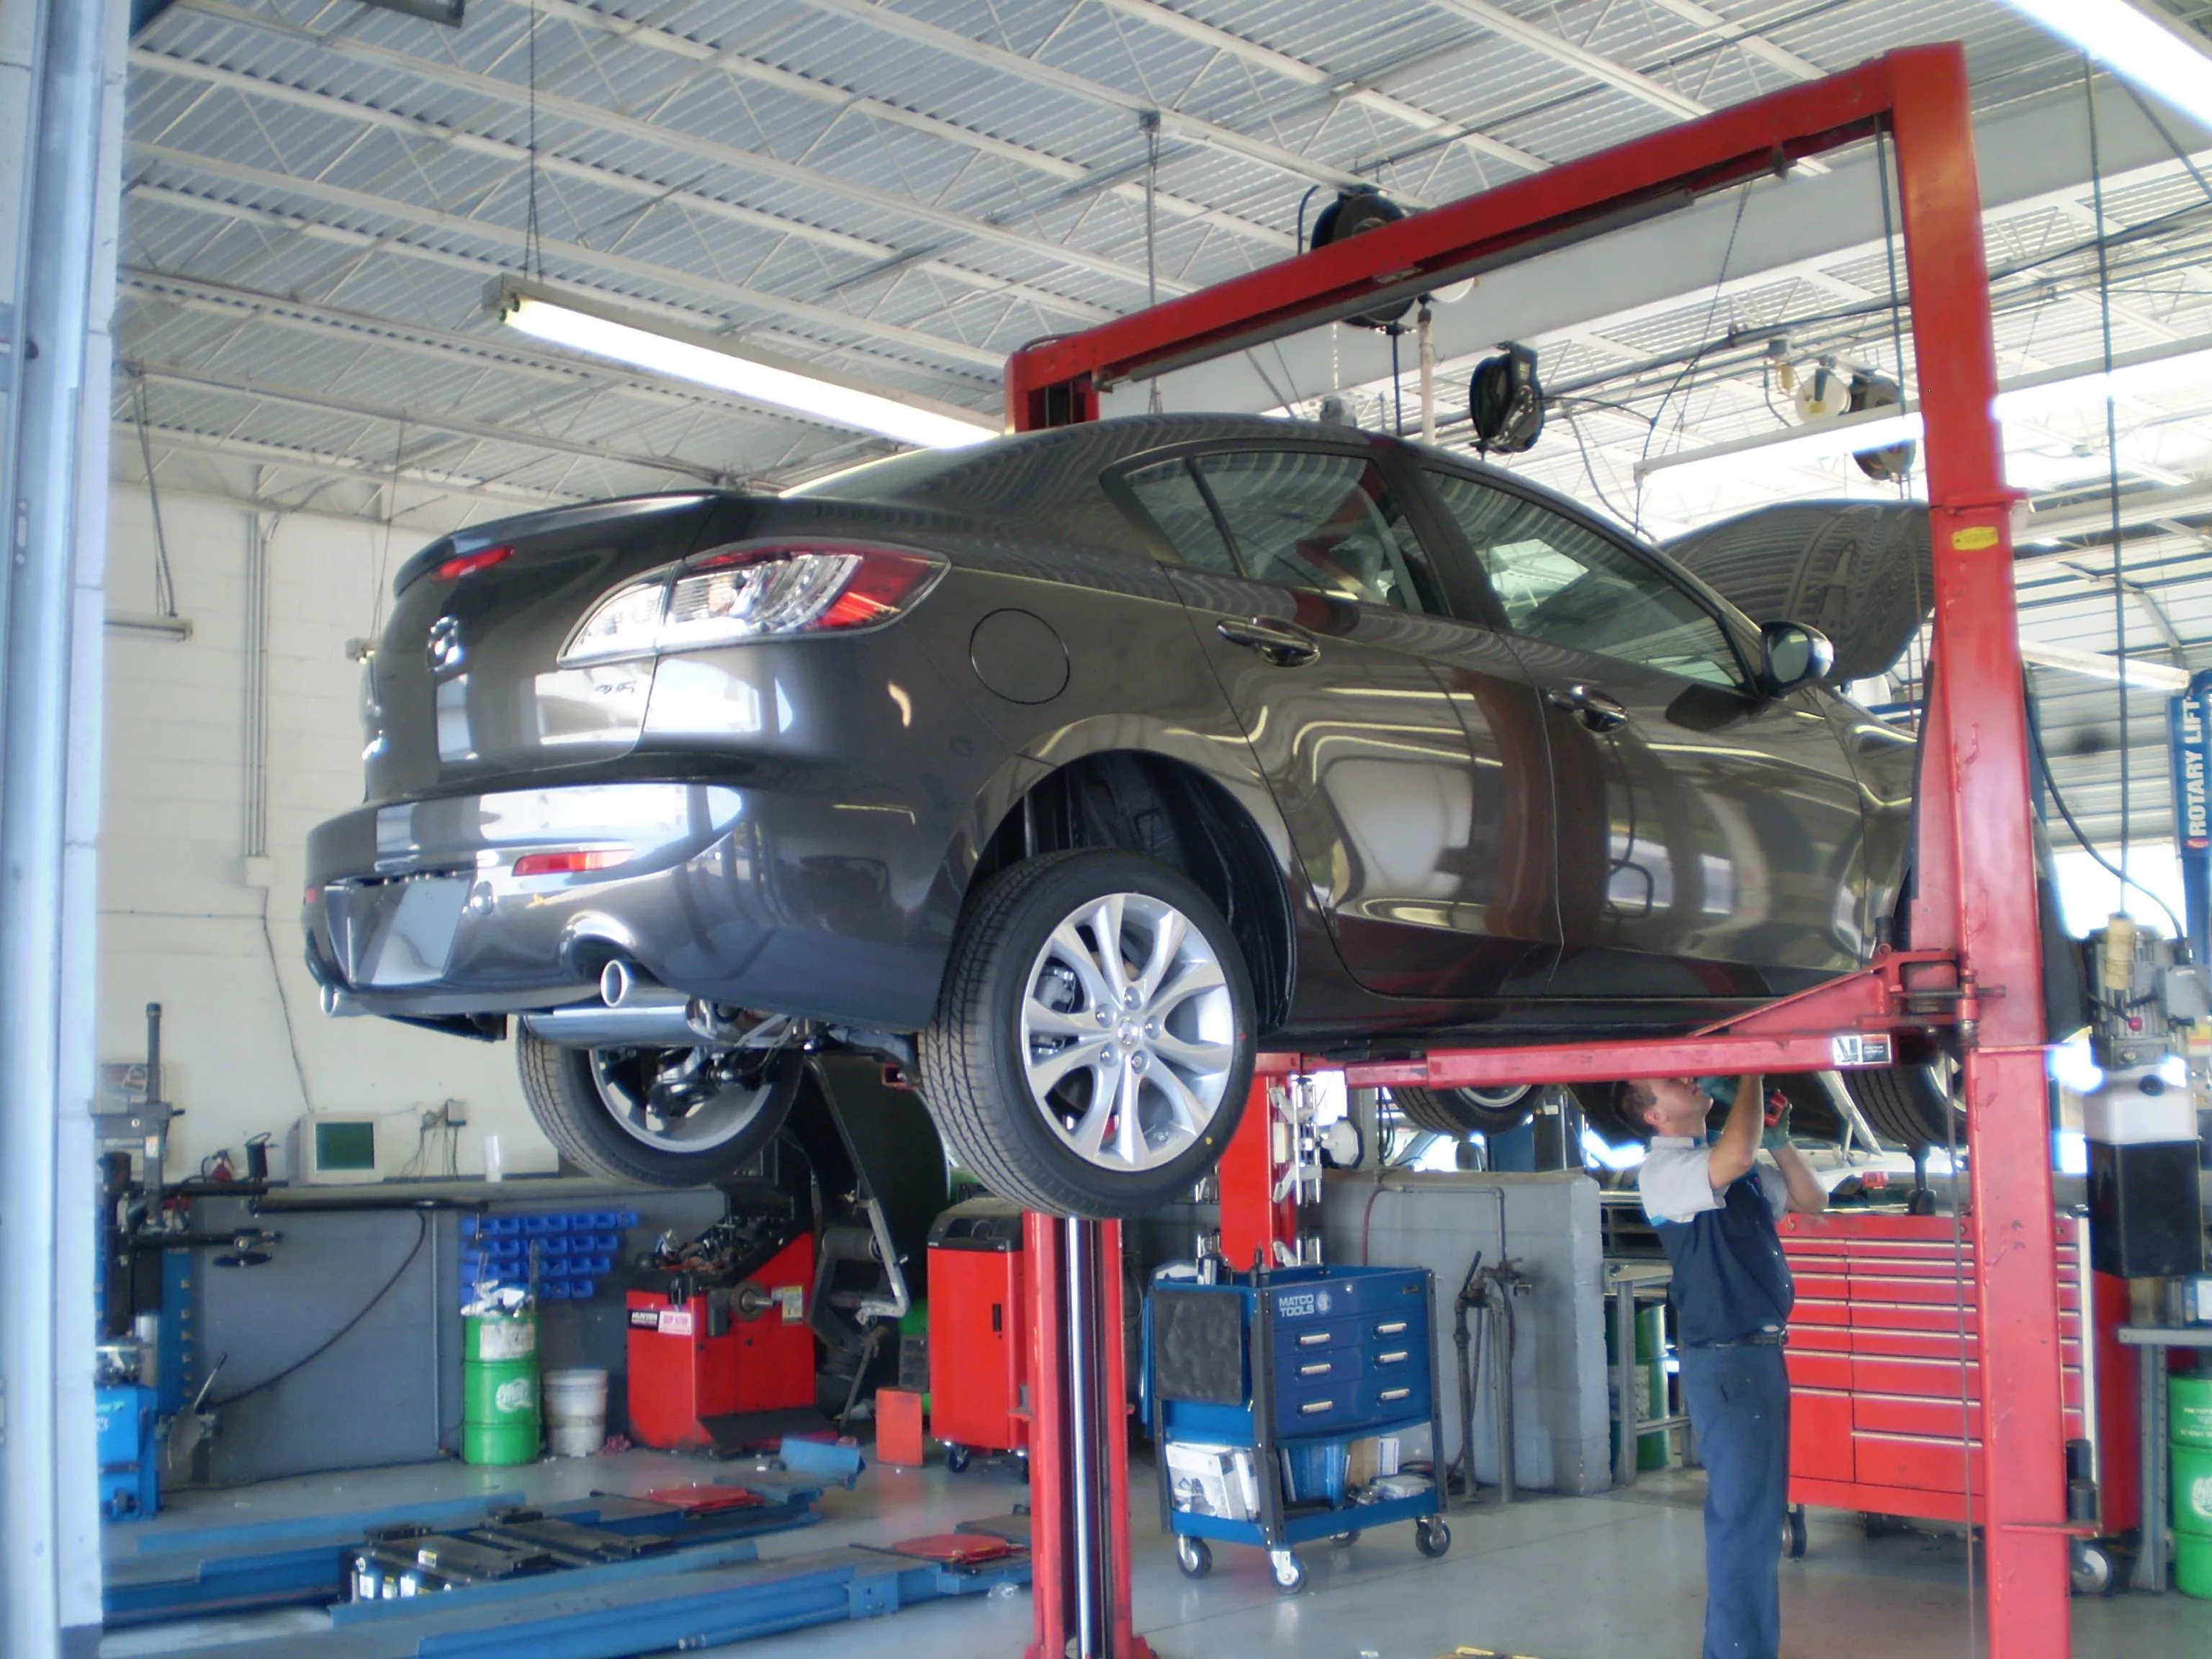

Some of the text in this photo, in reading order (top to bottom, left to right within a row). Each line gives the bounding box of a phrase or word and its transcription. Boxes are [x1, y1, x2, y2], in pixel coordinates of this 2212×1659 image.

[2182, 699, 2207, 837] ROTARY LIFT
[1279, 1294, 1314, 1308] MATCO
[1280, 1304, 1315, 1318] TOOLS
